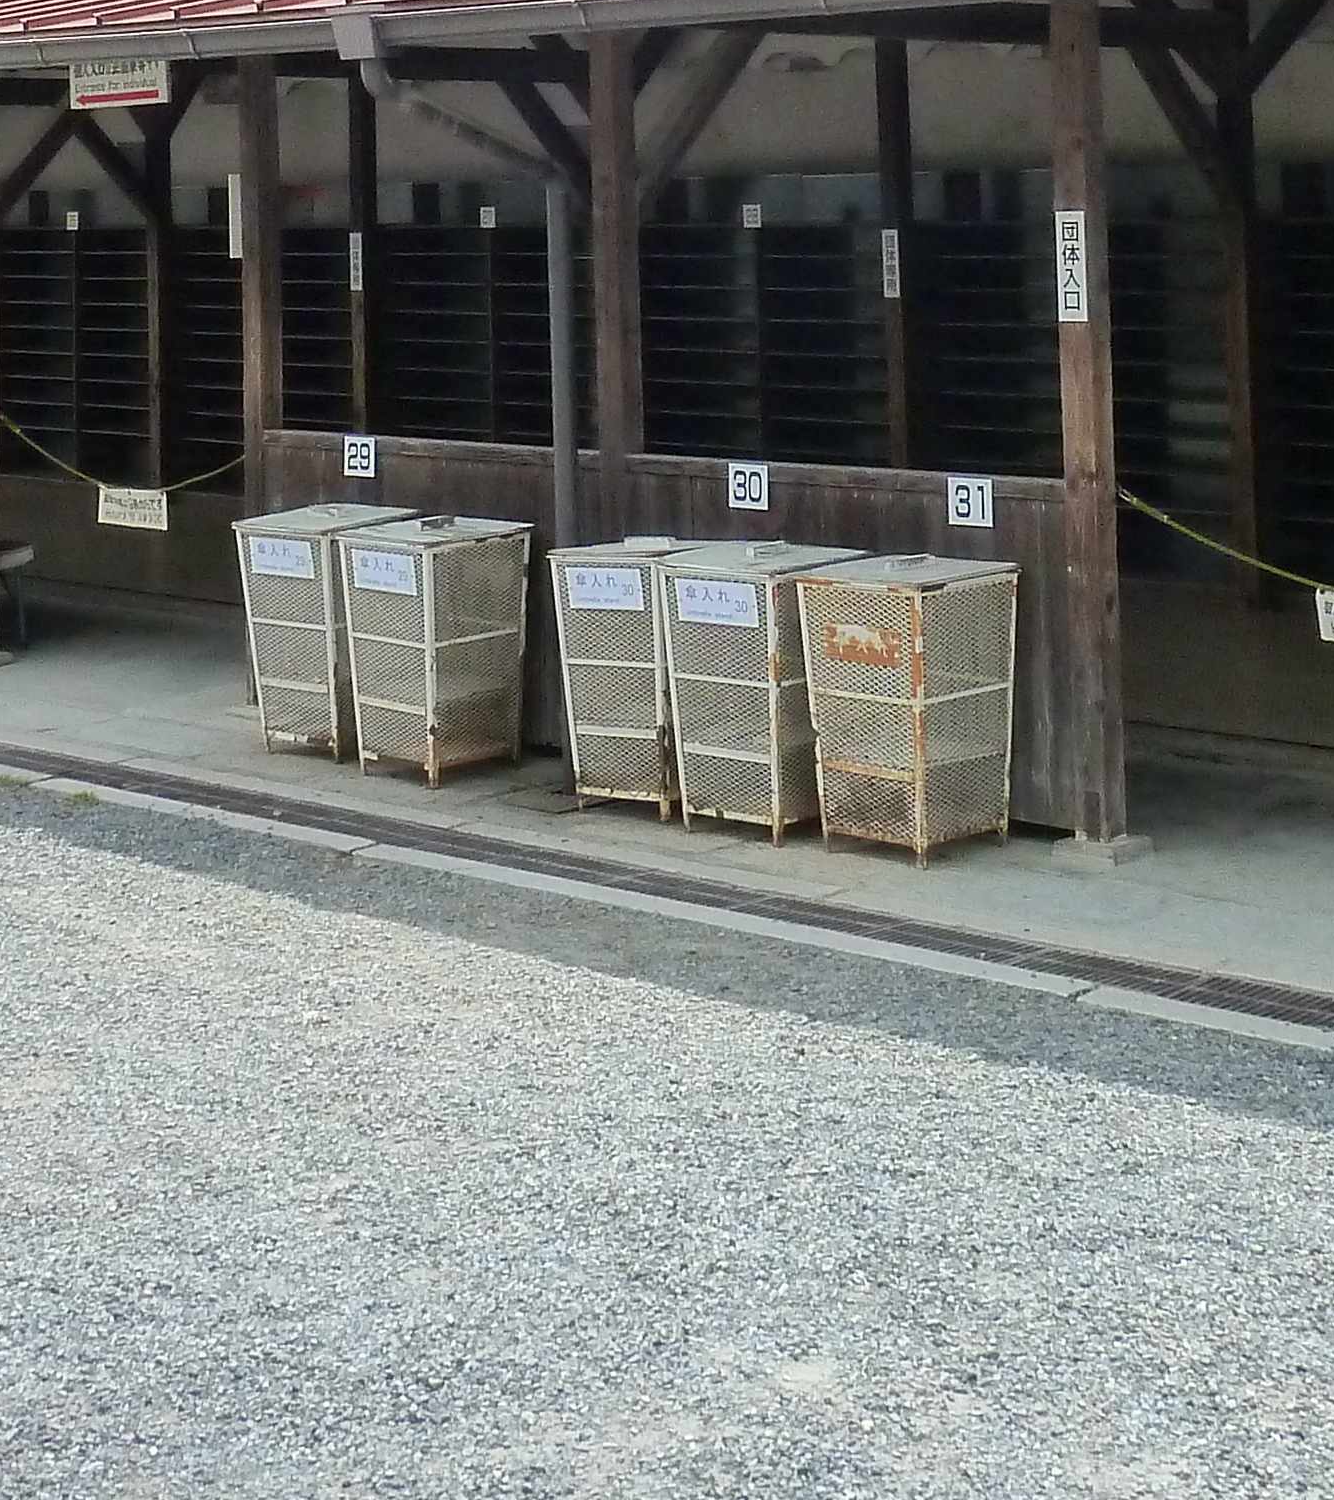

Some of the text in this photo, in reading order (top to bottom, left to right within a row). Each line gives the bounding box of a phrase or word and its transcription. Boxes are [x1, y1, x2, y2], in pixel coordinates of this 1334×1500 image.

[1062, 221, 1080, 311] 団体入口
[348, 442, 370, 470] 29
[734, 470, 762, 503] 30
[955, 484, 985, 520] 31
[258, 542, 292, 558] 傘入れ
[360, 556, 395, 572] 傘入れ
[576, 573, 617, 588] 傘入れ
[622, 584, 634, 596] 30
[685, 585, 730, 603] 傘入れ
[735, 600, 748, 613] 30
